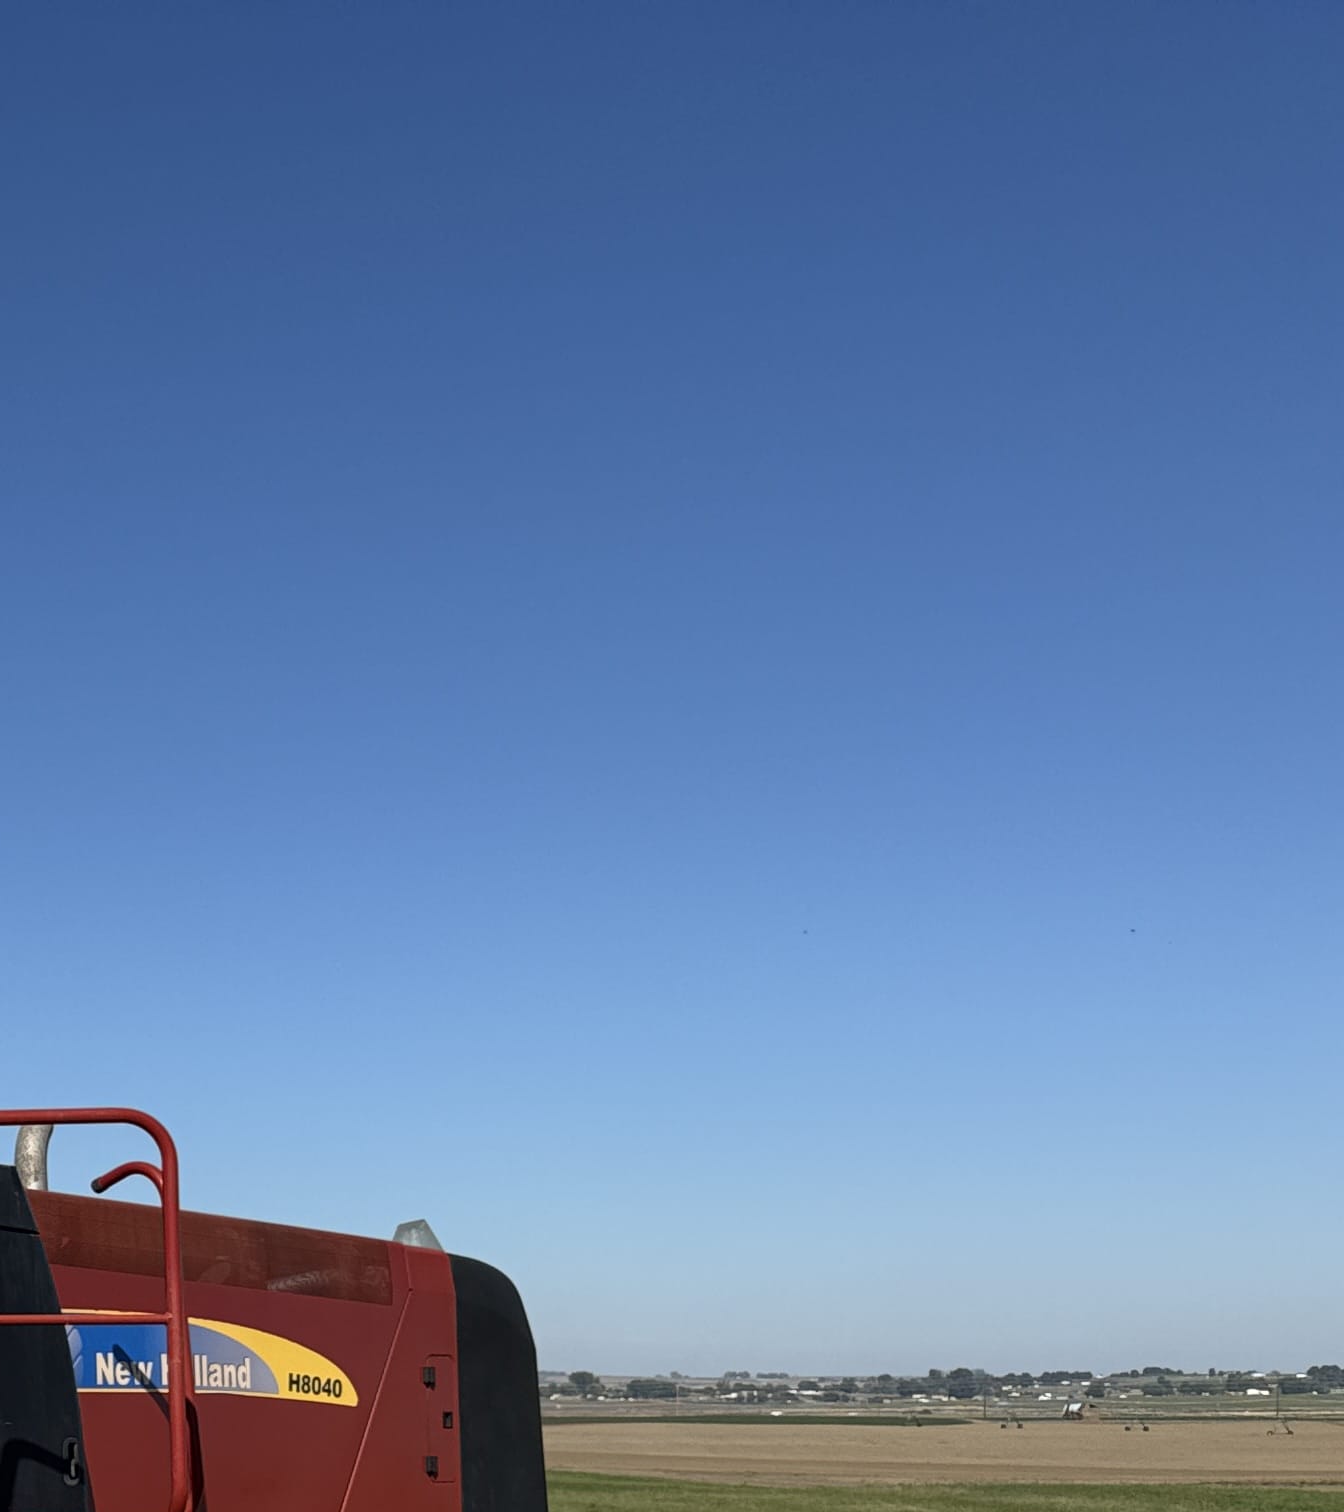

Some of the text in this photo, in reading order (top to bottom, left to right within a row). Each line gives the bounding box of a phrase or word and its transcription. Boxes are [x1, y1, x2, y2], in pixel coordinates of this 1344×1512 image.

[96, 1352, 251, 1389] New lland
[288, 1373, 343, 1398] H8040
